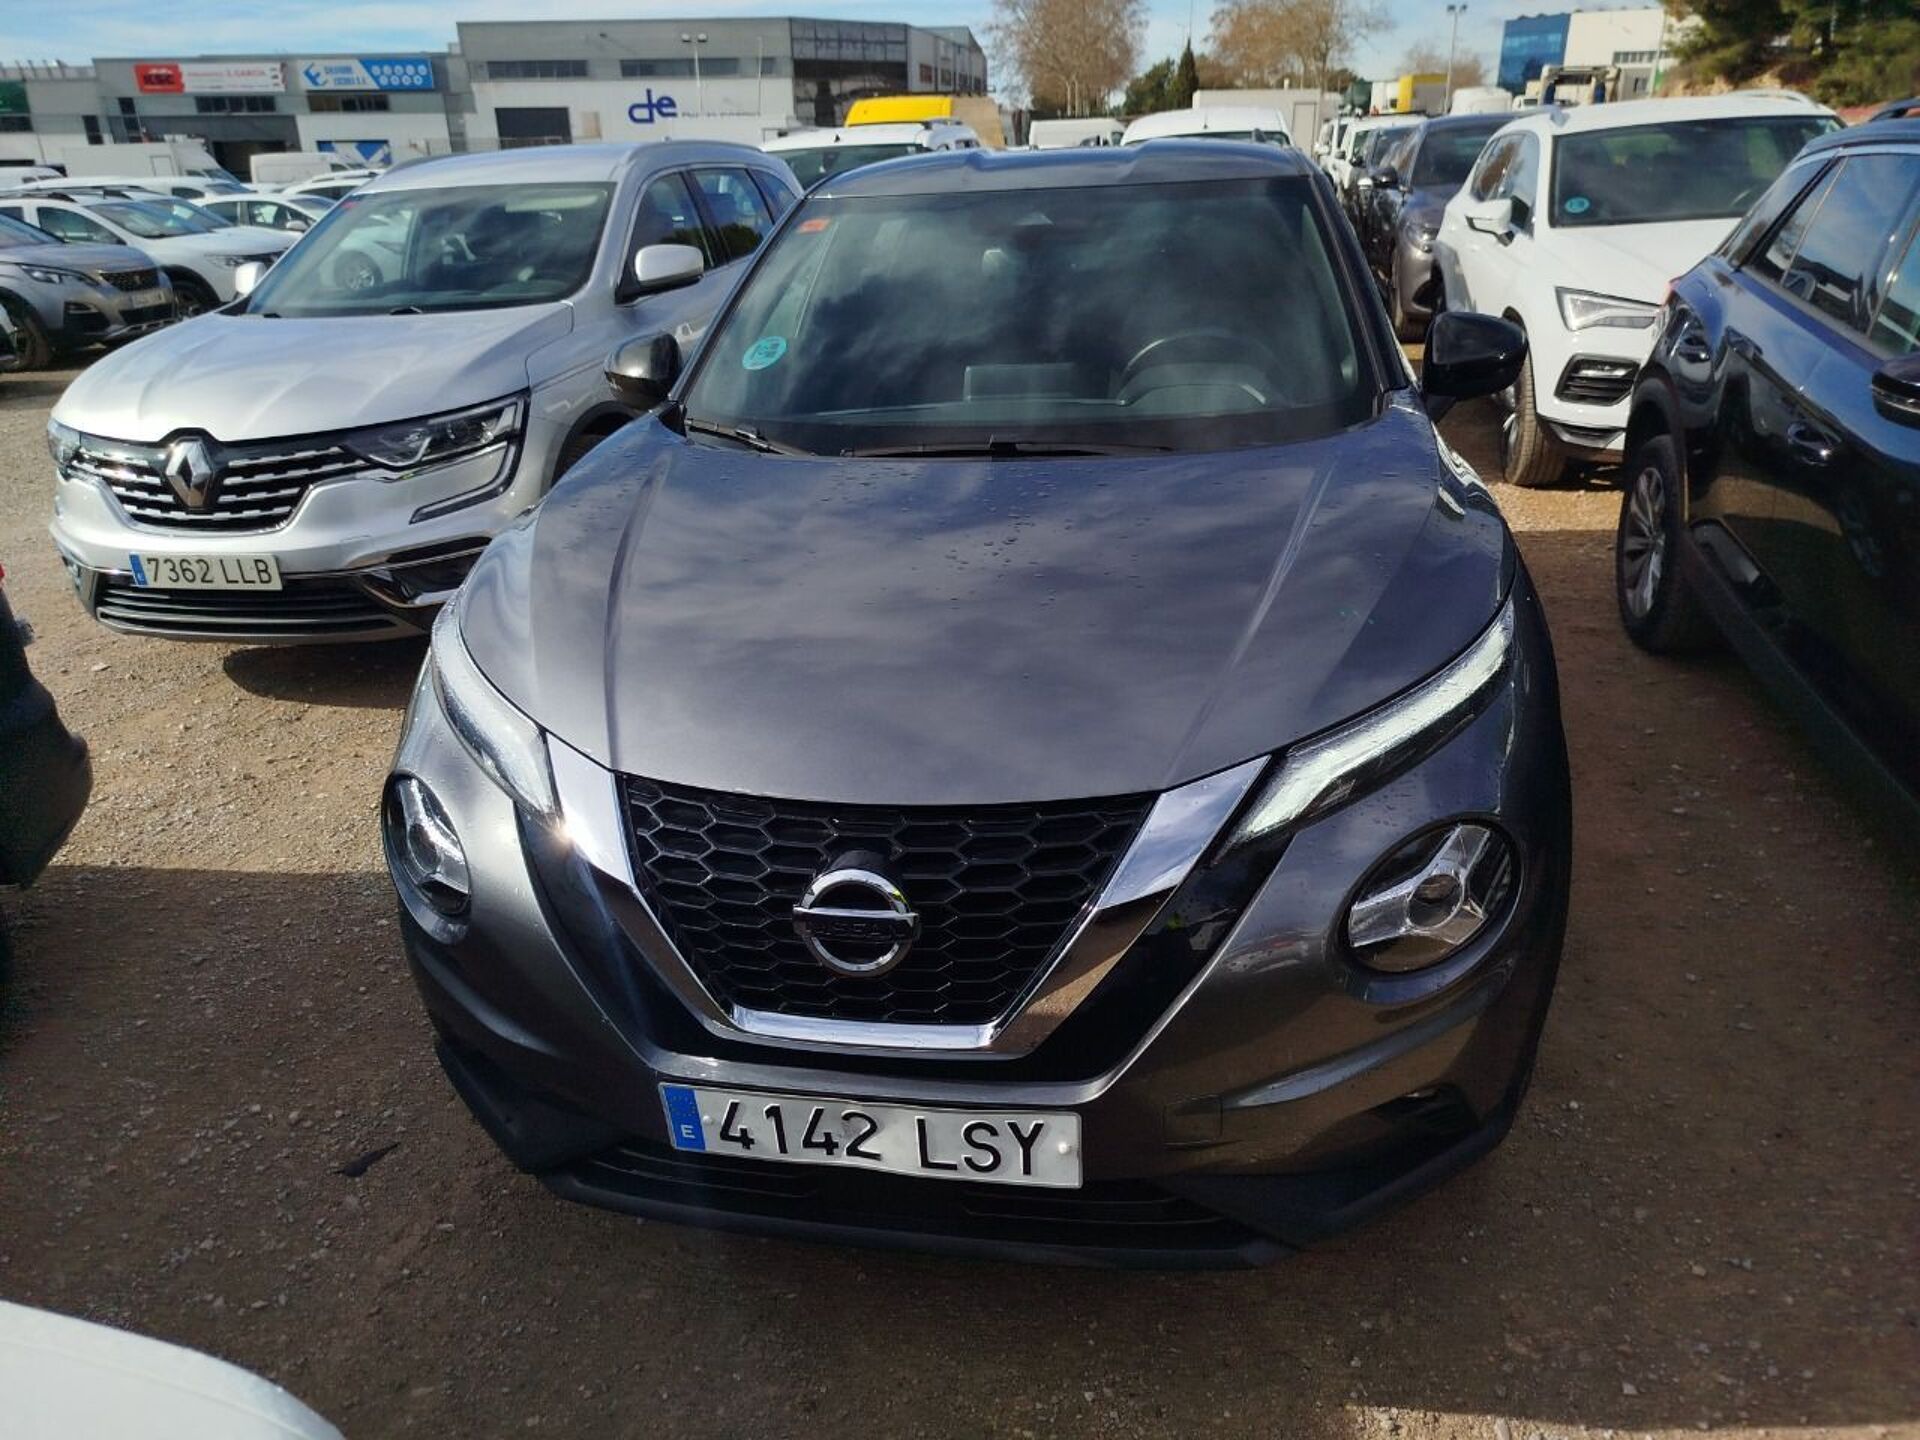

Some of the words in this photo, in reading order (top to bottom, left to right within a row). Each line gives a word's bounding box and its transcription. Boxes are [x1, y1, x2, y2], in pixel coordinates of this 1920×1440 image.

[628, 88, 678, 124] de
[147, 557, 214, 583] 7362
[219, 558, 272, 585] LLB
[680, 1124, 696, 1140] E
[718, 1099, 882, 1162] 4142
[914, 1115, 1045, 1177] LSY
